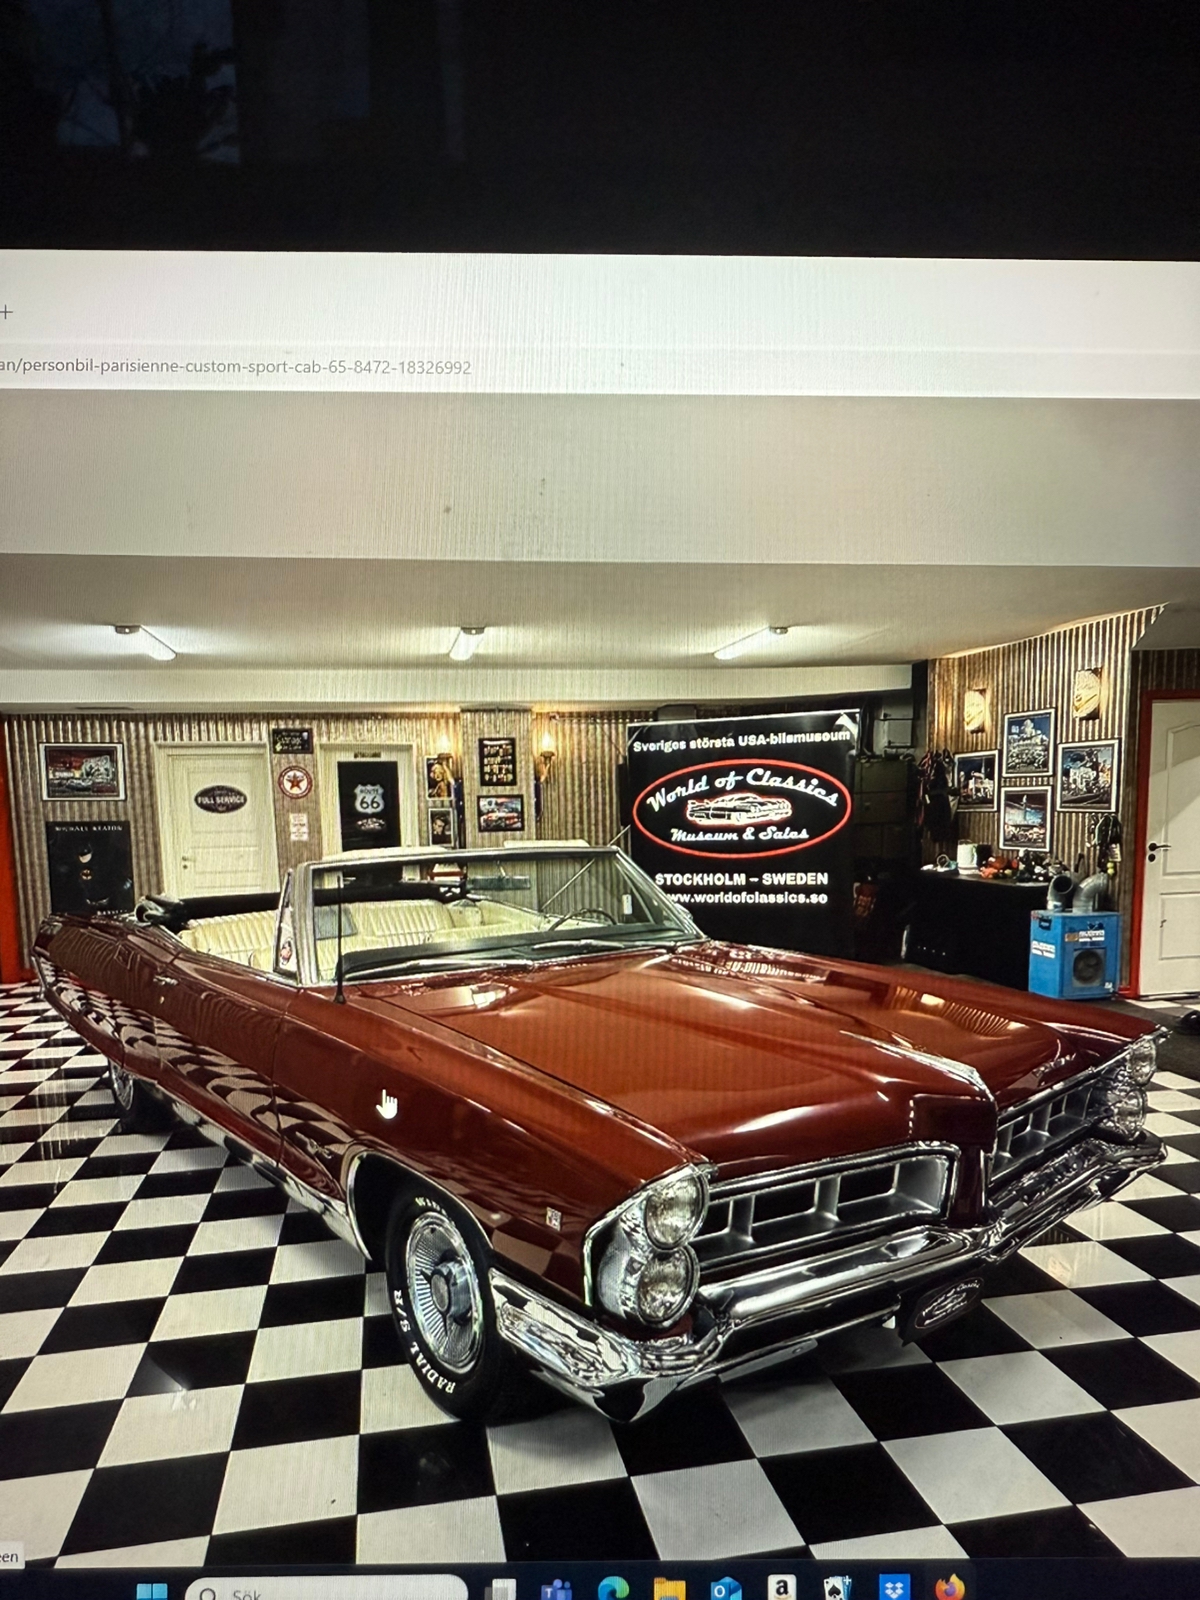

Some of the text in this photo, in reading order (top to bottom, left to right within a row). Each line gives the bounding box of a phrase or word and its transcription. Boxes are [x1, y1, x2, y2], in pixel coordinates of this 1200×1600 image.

[646, 767, 839, 812] World of Classics
[360, 796, 380, 810] 66
[670, 825, 809, 842] Museum & Sales
[655, 872, 746, 886] STOCKHOLM
[762, 872, 828, 886] SWEDEN
[666, 890, 828, 904] ww.worldofclassics.se
[410, 1341, 456, 1394] RADIAL
[0, 1552, 19, 1563] en
